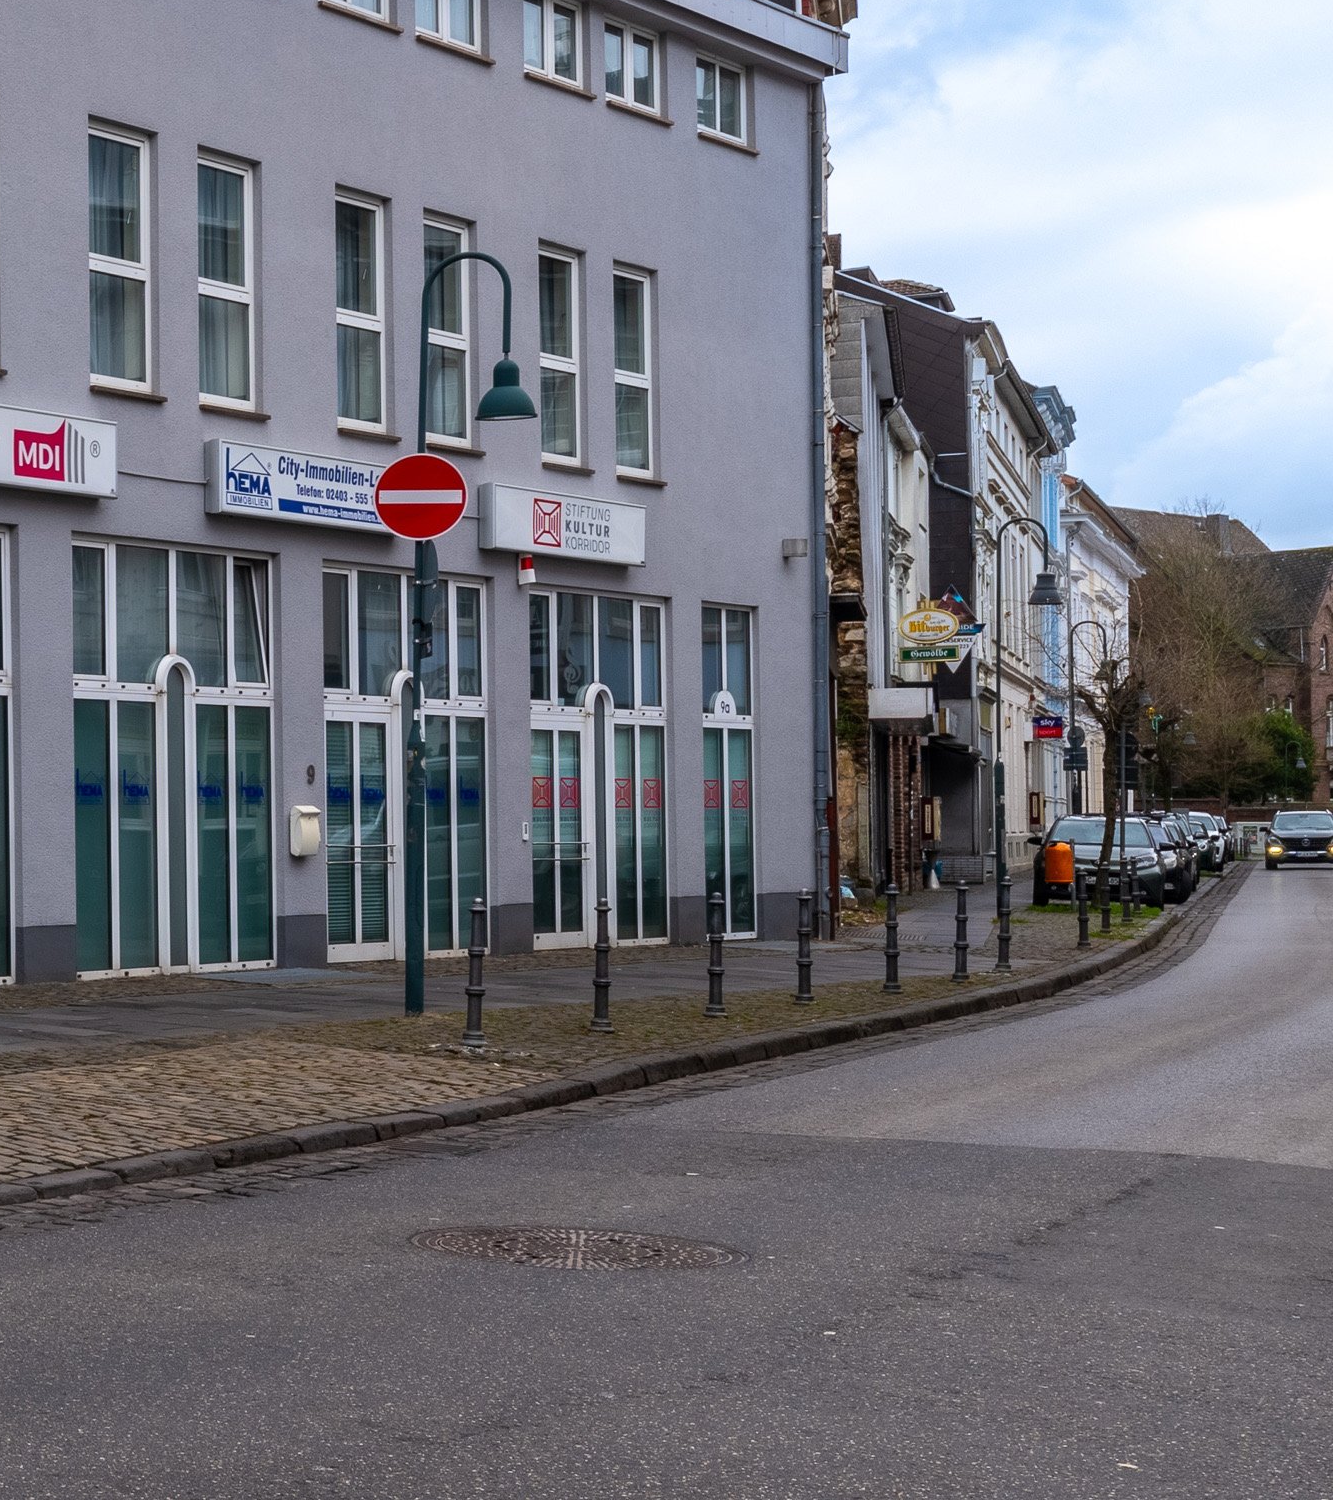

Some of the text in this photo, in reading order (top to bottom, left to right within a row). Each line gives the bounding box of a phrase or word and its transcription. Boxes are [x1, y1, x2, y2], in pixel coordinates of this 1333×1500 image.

[18, 440, 60, 472] MDI
[230, 494, 269, 507] IMMOBILIEN
[296, 484, 324, 498] Telefon:
[326, 488, 347, 502] 02403
[355, 492, 368, 505] 555
[302, 504, 382, 523] www.hema-immobilien.
[565, 503, 610, 522] STIFTUNG
[565, 519, 610, 538] KULTUR
[565, 536, 610, 554] KORRIDOR
[908, 620, 950, 633] Bitburger
[721, 701, 730, 713] 9a
[1040, 718, 1055, 727] sky
[307, 764, 315, 785] 9
